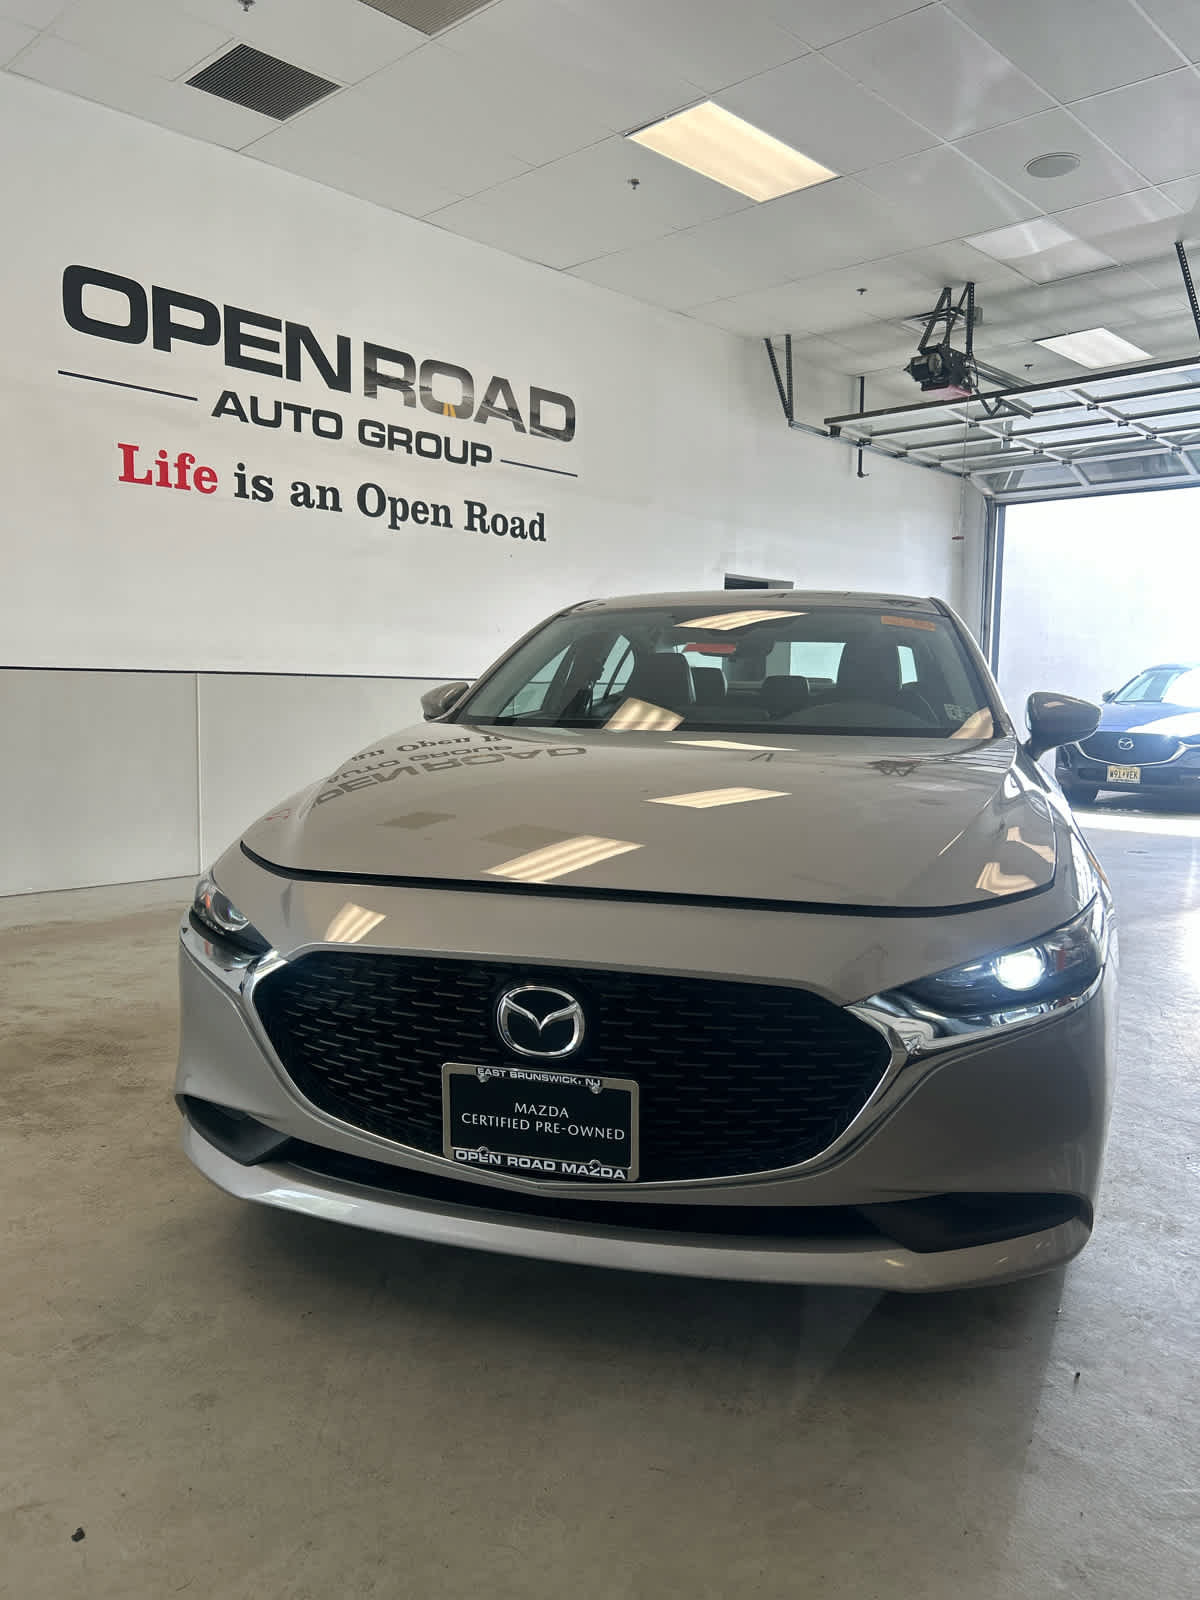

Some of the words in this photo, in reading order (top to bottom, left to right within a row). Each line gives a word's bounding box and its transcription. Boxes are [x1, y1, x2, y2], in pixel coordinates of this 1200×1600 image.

[62, 264, 352, 393] OPEN
[363, 341, 577, 443] ROAD
[211, 390, 343, 441] AUTO
[358, 419, 493, 467] GROUP
[117, 443, 219, 494] Life
[233, 462, 274, 503] is
[290, 479, 343, 513] an
[356, 482, 453, 530] Open
[464, 500, 547, 542] Road
[477, 1067, 506, 1077] EAST
[585, 1078, 601, 1087] NJ
[514, 1102, 569, 1118] MAZDA
[461, 1112, 530, 1130] CERTIFIED
[535, 1121, 625, 1141] PRE-OWNED
[455, 1150, 501, 1164] OPEN
[507, 1156, 556, 1171] ROAD
[561, 1163, 626, 1180] MAZDA
